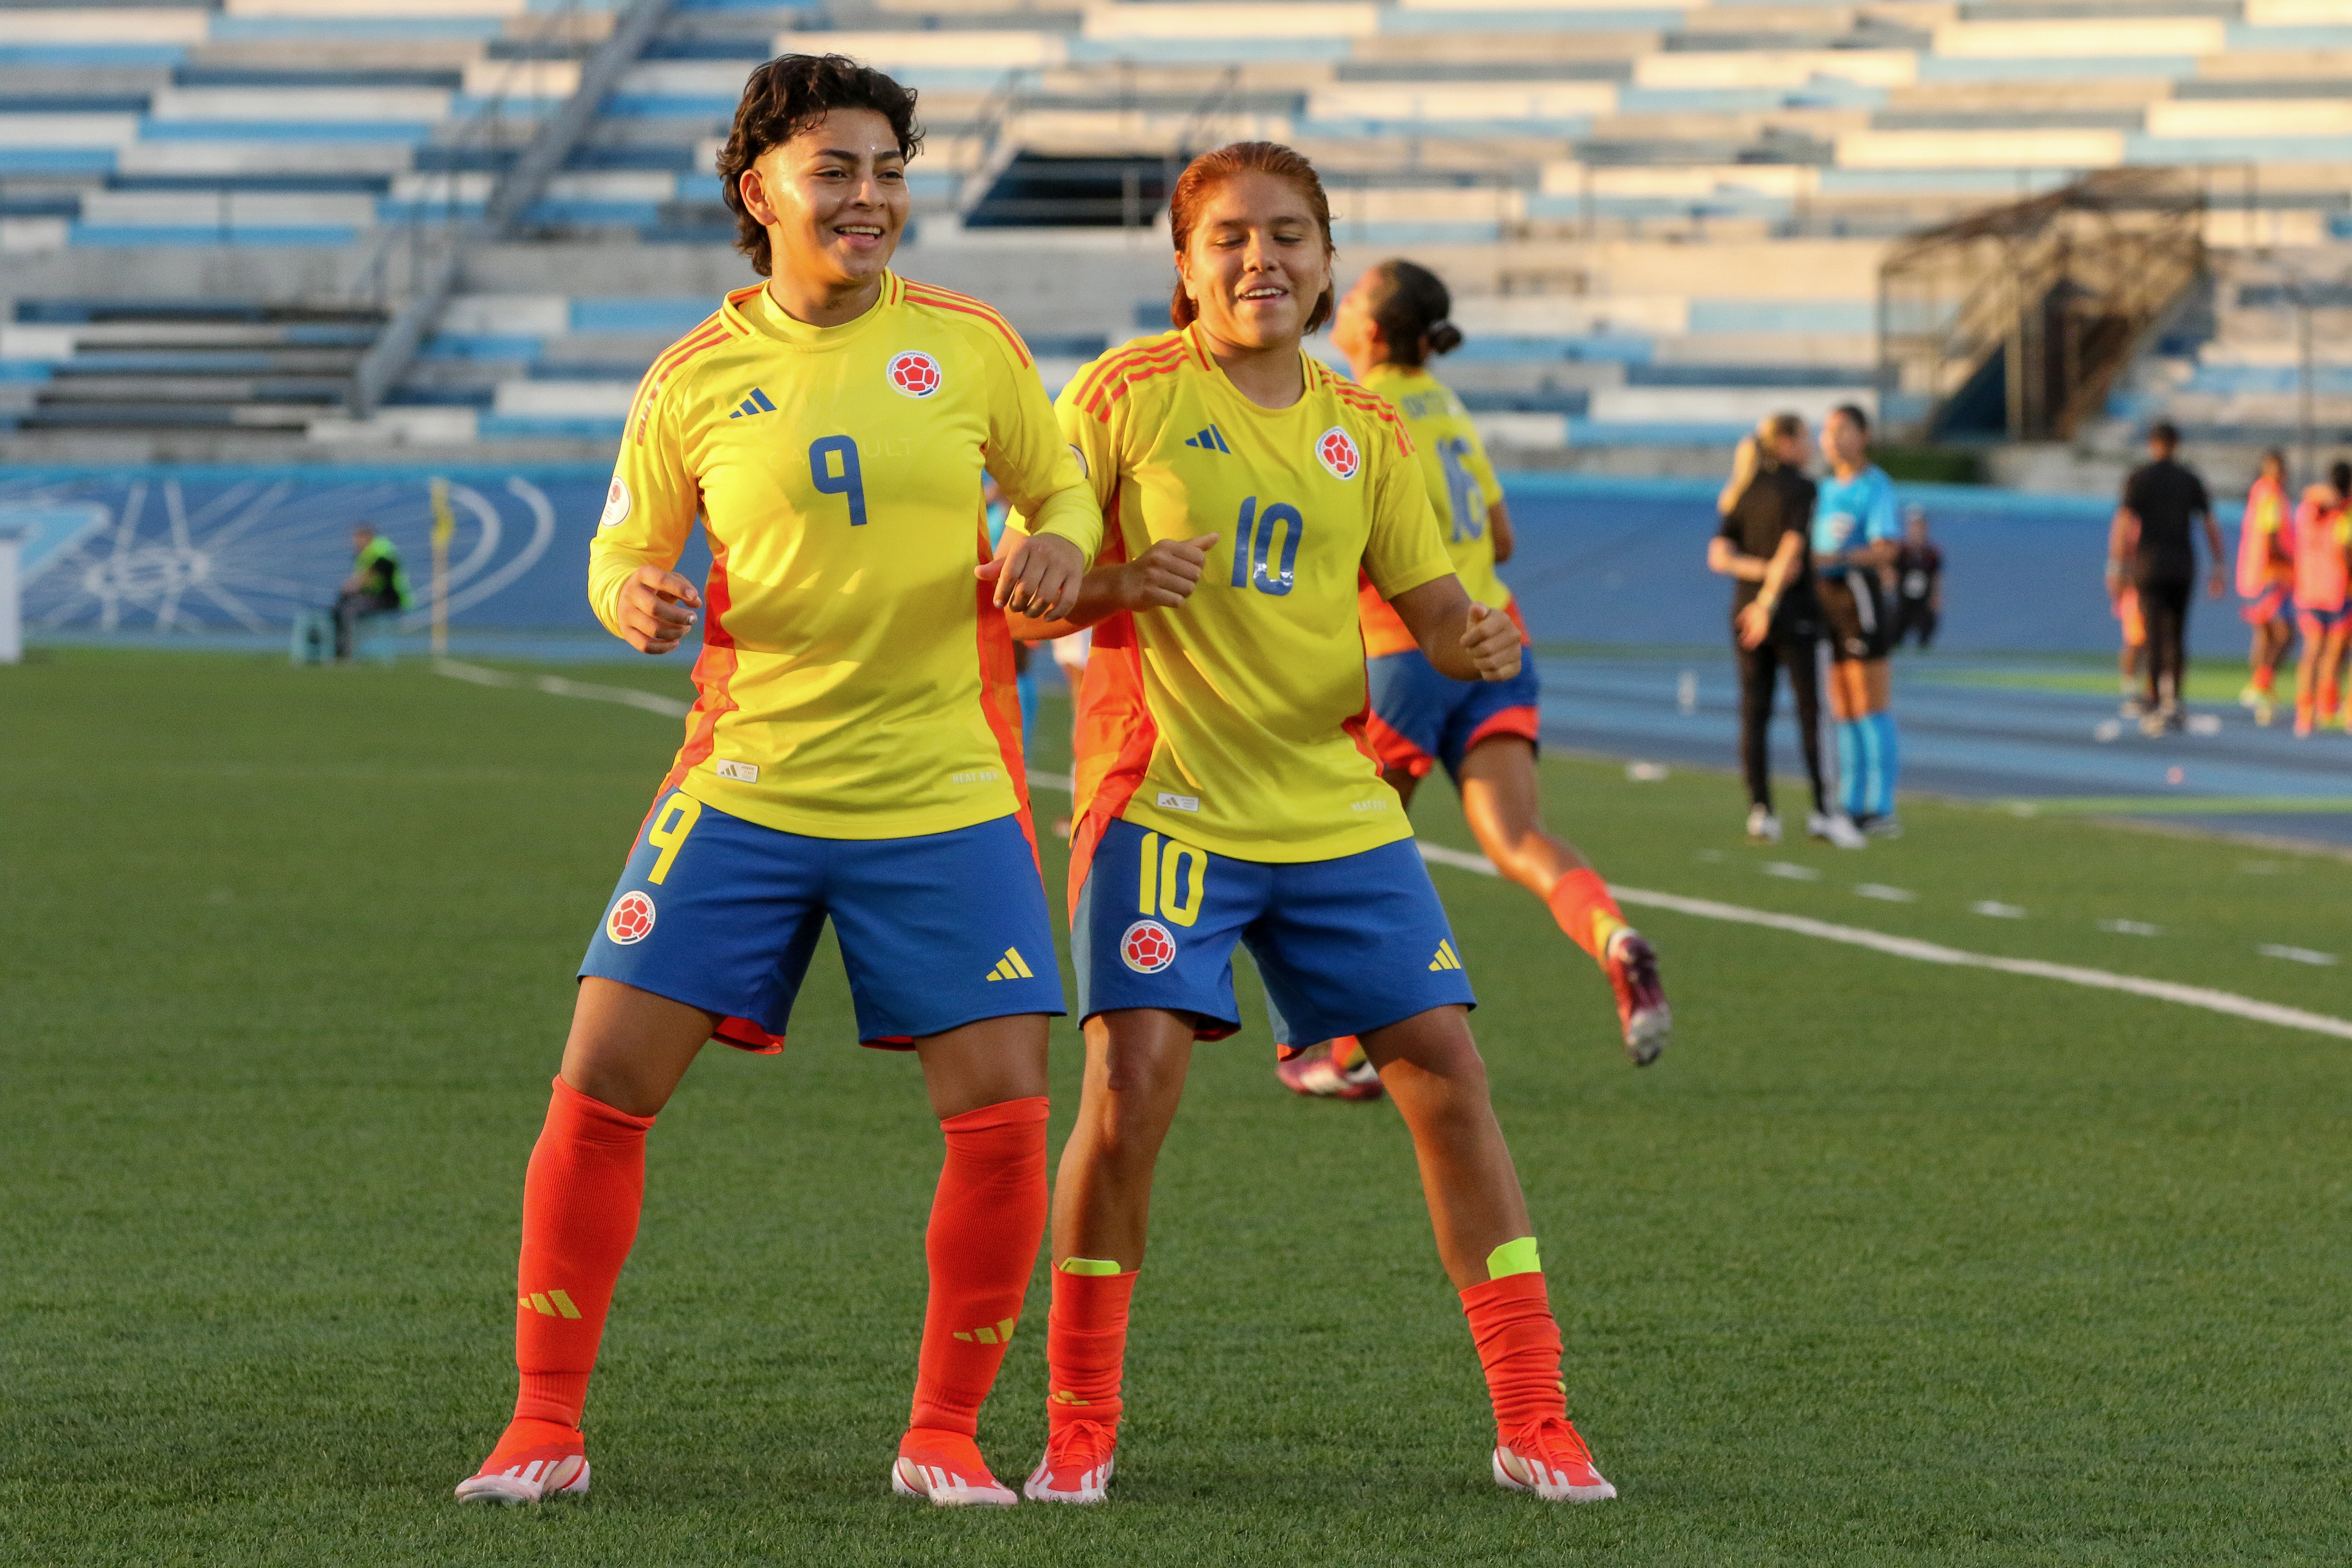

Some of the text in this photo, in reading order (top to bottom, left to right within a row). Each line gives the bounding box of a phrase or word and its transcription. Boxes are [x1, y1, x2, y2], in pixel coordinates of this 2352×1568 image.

[809, 435, 867, 526] 9
[1231, 496, 1303, 596] 10
[648, 793, 701, 885] 9
[1139, 832, 1208, 927] 10
